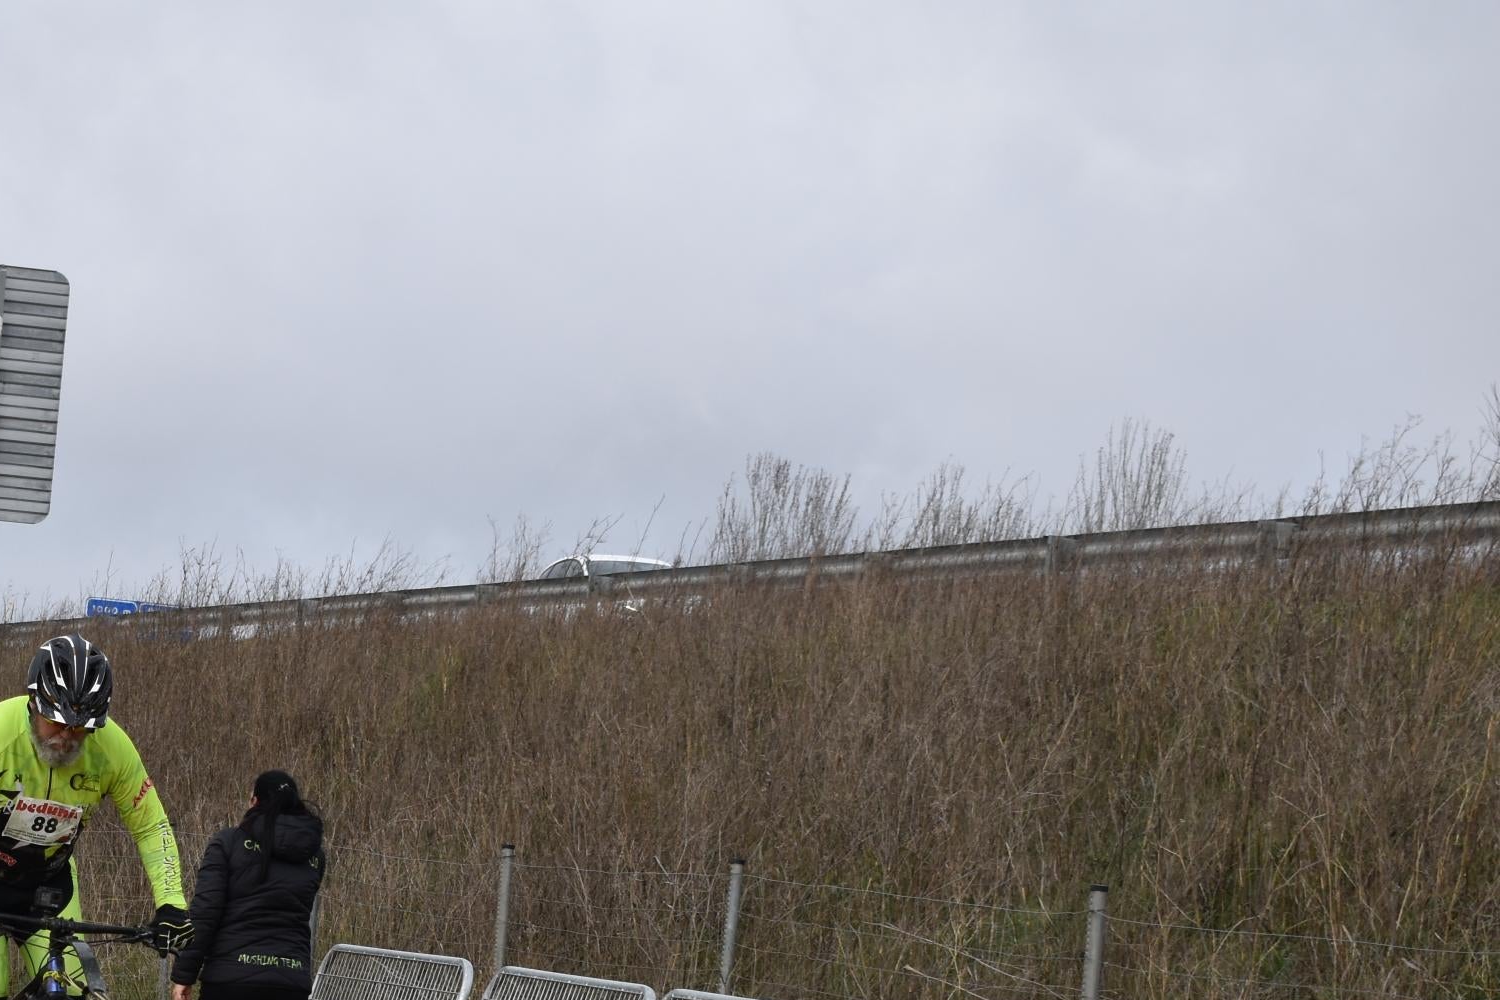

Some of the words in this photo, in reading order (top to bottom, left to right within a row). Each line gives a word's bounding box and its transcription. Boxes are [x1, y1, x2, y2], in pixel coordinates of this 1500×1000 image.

[31, 816, 59, 834] 88
[238, 954, 279, 967] MUSHING
[280, 957, 302, 970] TEAM
